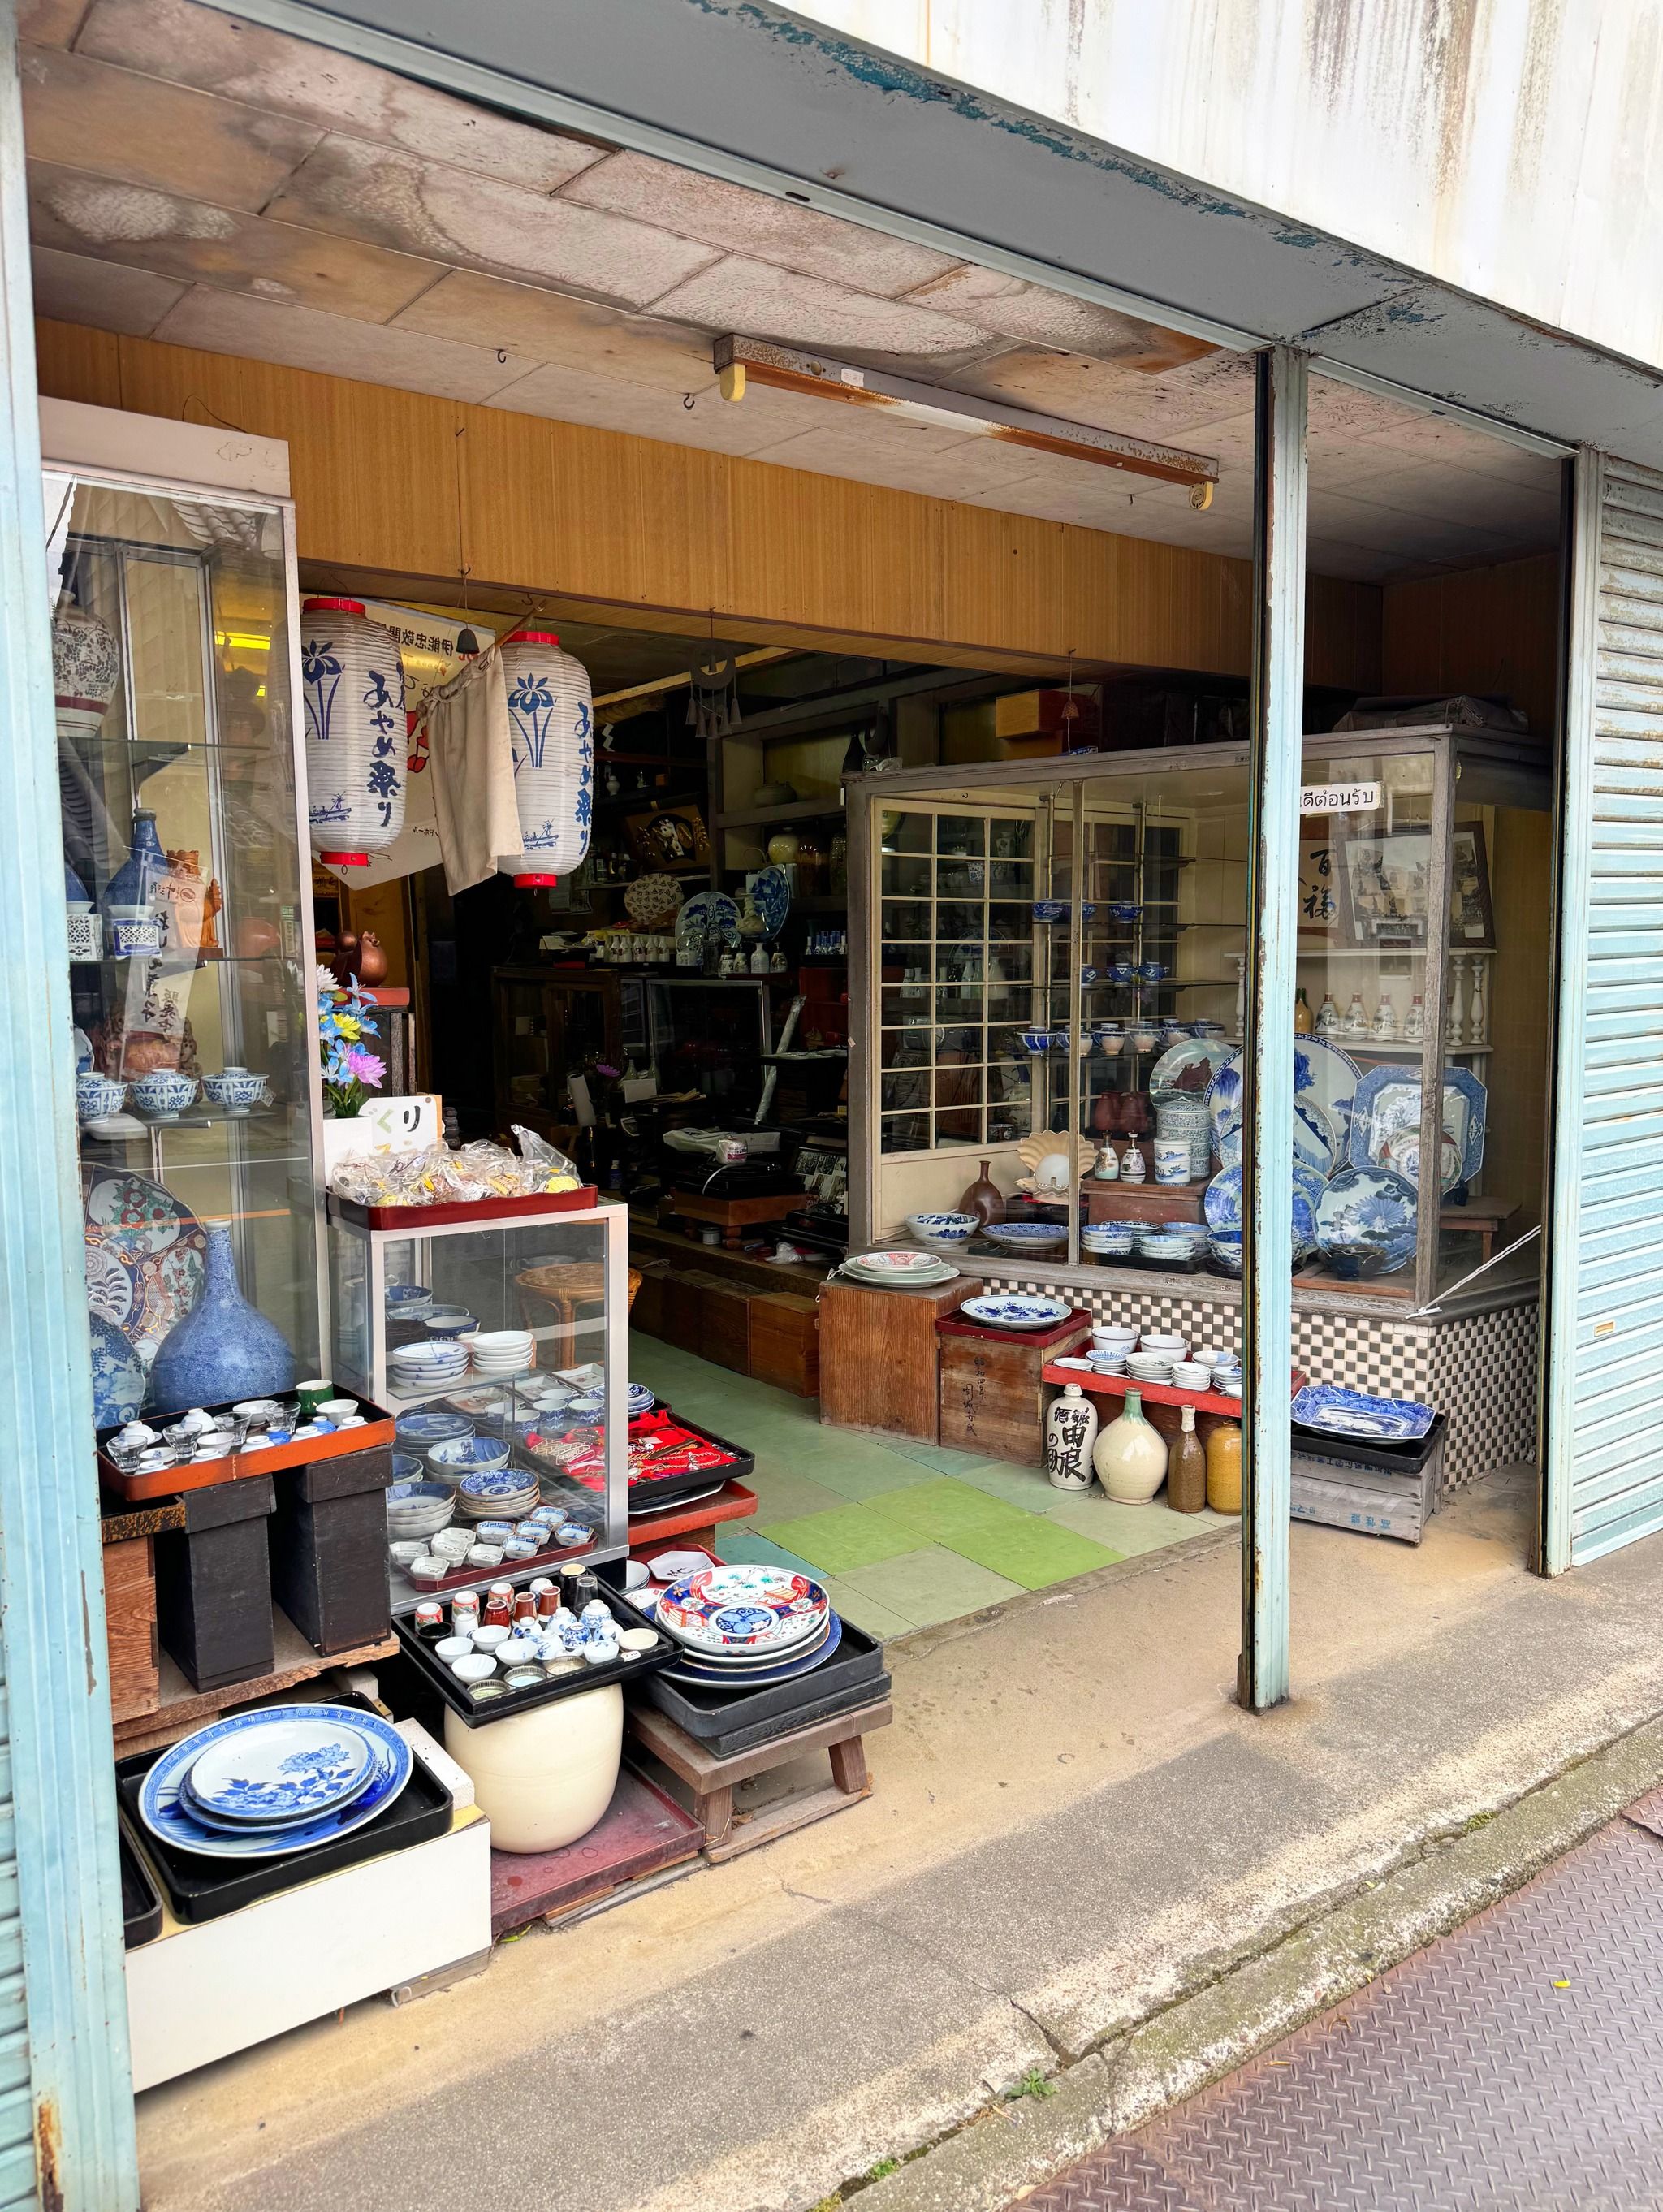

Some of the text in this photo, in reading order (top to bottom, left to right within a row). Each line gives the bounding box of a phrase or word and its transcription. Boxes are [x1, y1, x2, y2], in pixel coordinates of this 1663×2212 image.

[364, 670, 401, 827] あやめ祭り
